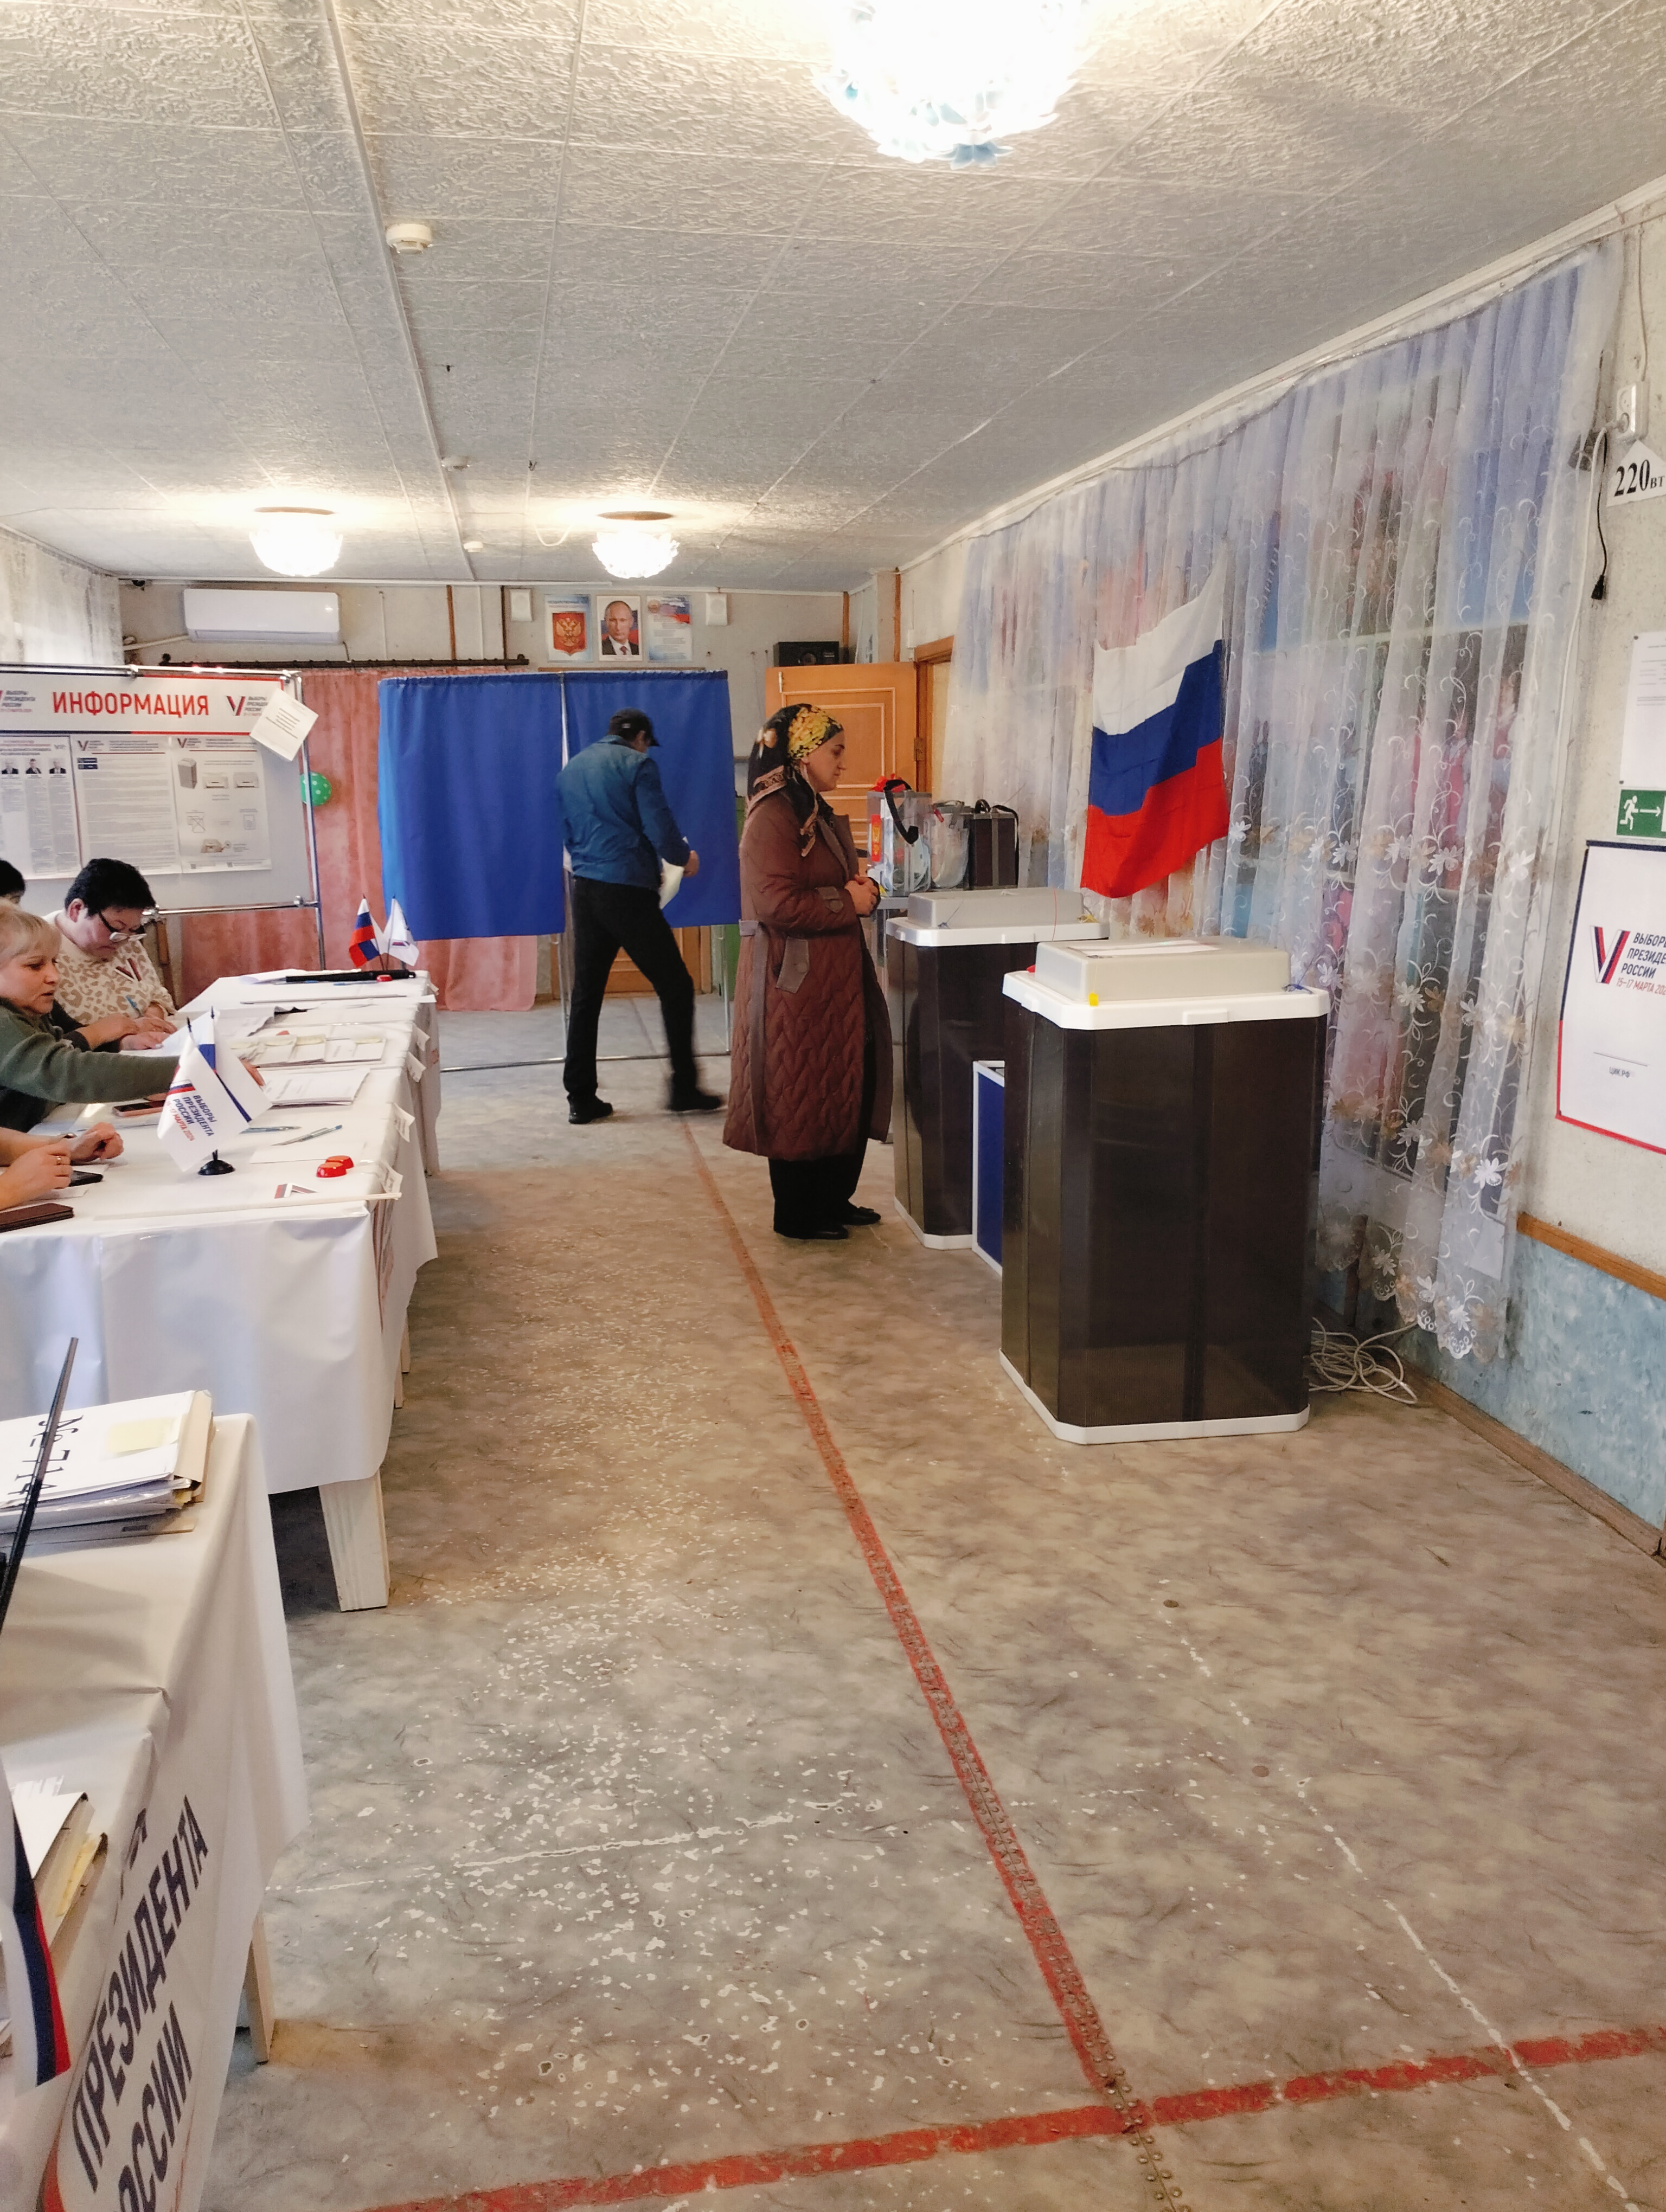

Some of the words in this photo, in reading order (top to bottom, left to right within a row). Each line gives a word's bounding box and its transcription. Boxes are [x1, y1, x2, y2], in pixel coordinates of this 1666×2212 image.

[53, 691, 209, 718] ИНФОРМАЦИЯ
[1626, 948, 1666, 965] ПРЕЗИДЕ
[1621, 963, 1657, 979] РОССИИ
[1633, 980, 1655, 993] МАРТА
[173, 1098, 195, 1124] РОССИИ
[182, 1096, 215, 1136] ПРЕЗИДЕНТА
[193, 1095, 217, 1122] ВЫБОРЫ
[72, 1795, 208, 2193] ПРЕЗИДЕНТА
[118, 2000, 193, 2212] ССИИ
